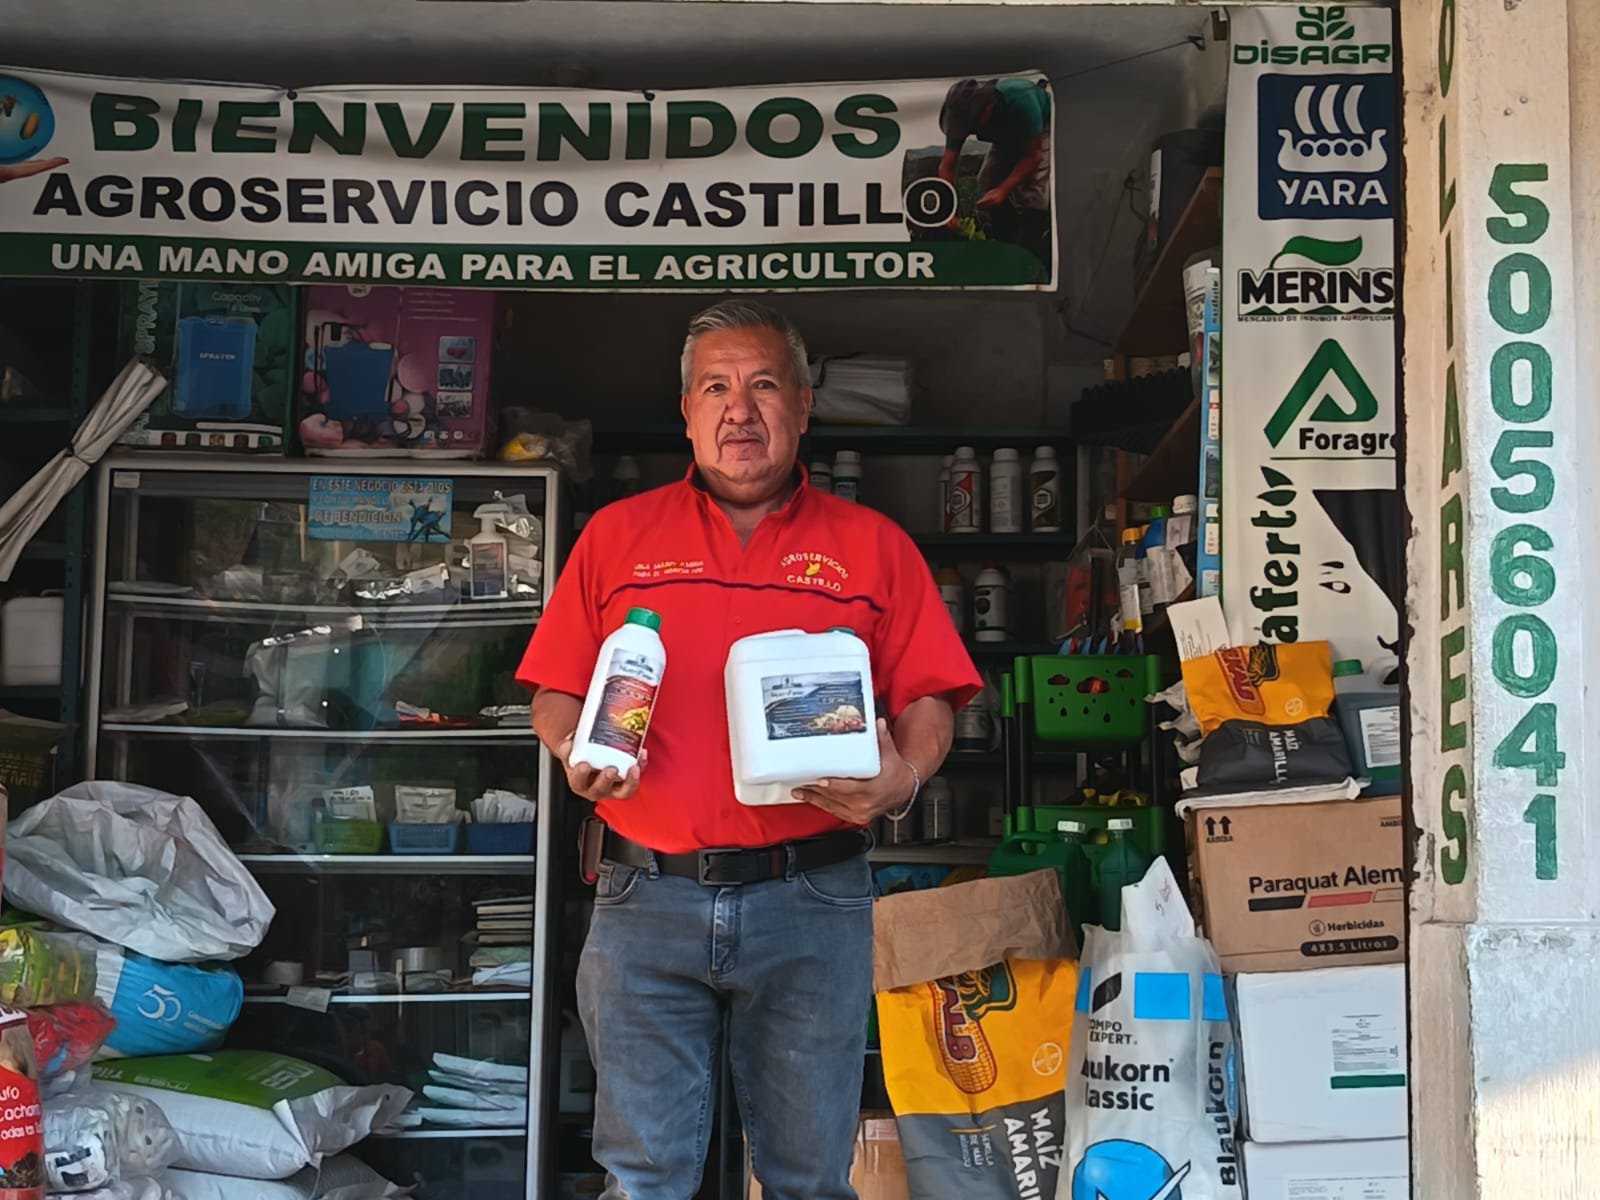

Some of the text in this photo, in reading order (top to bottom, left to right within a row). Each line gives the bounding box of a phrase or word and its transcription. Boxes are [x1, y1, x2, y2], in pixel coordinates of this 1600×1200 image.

[90, 93, 902, 162] BIENVENIDOS
[34, 172, 957, 228] AGROSERVICIO CASTILLO
[1277, 179, 1389, 207] YARA
[51, 243, 936, 282] UNA MANO AMIGA PARA EL AGRICULTOR
[1486, 163, 1566, 880] 50056041
[1249, 871, 1339, 894] Paraquat
[1327, 919, 1385, 932] Herbicidas
[1351, 940, 1389, 952] Litros
[1205, 1041, 1238, 1186] Blaukorn
